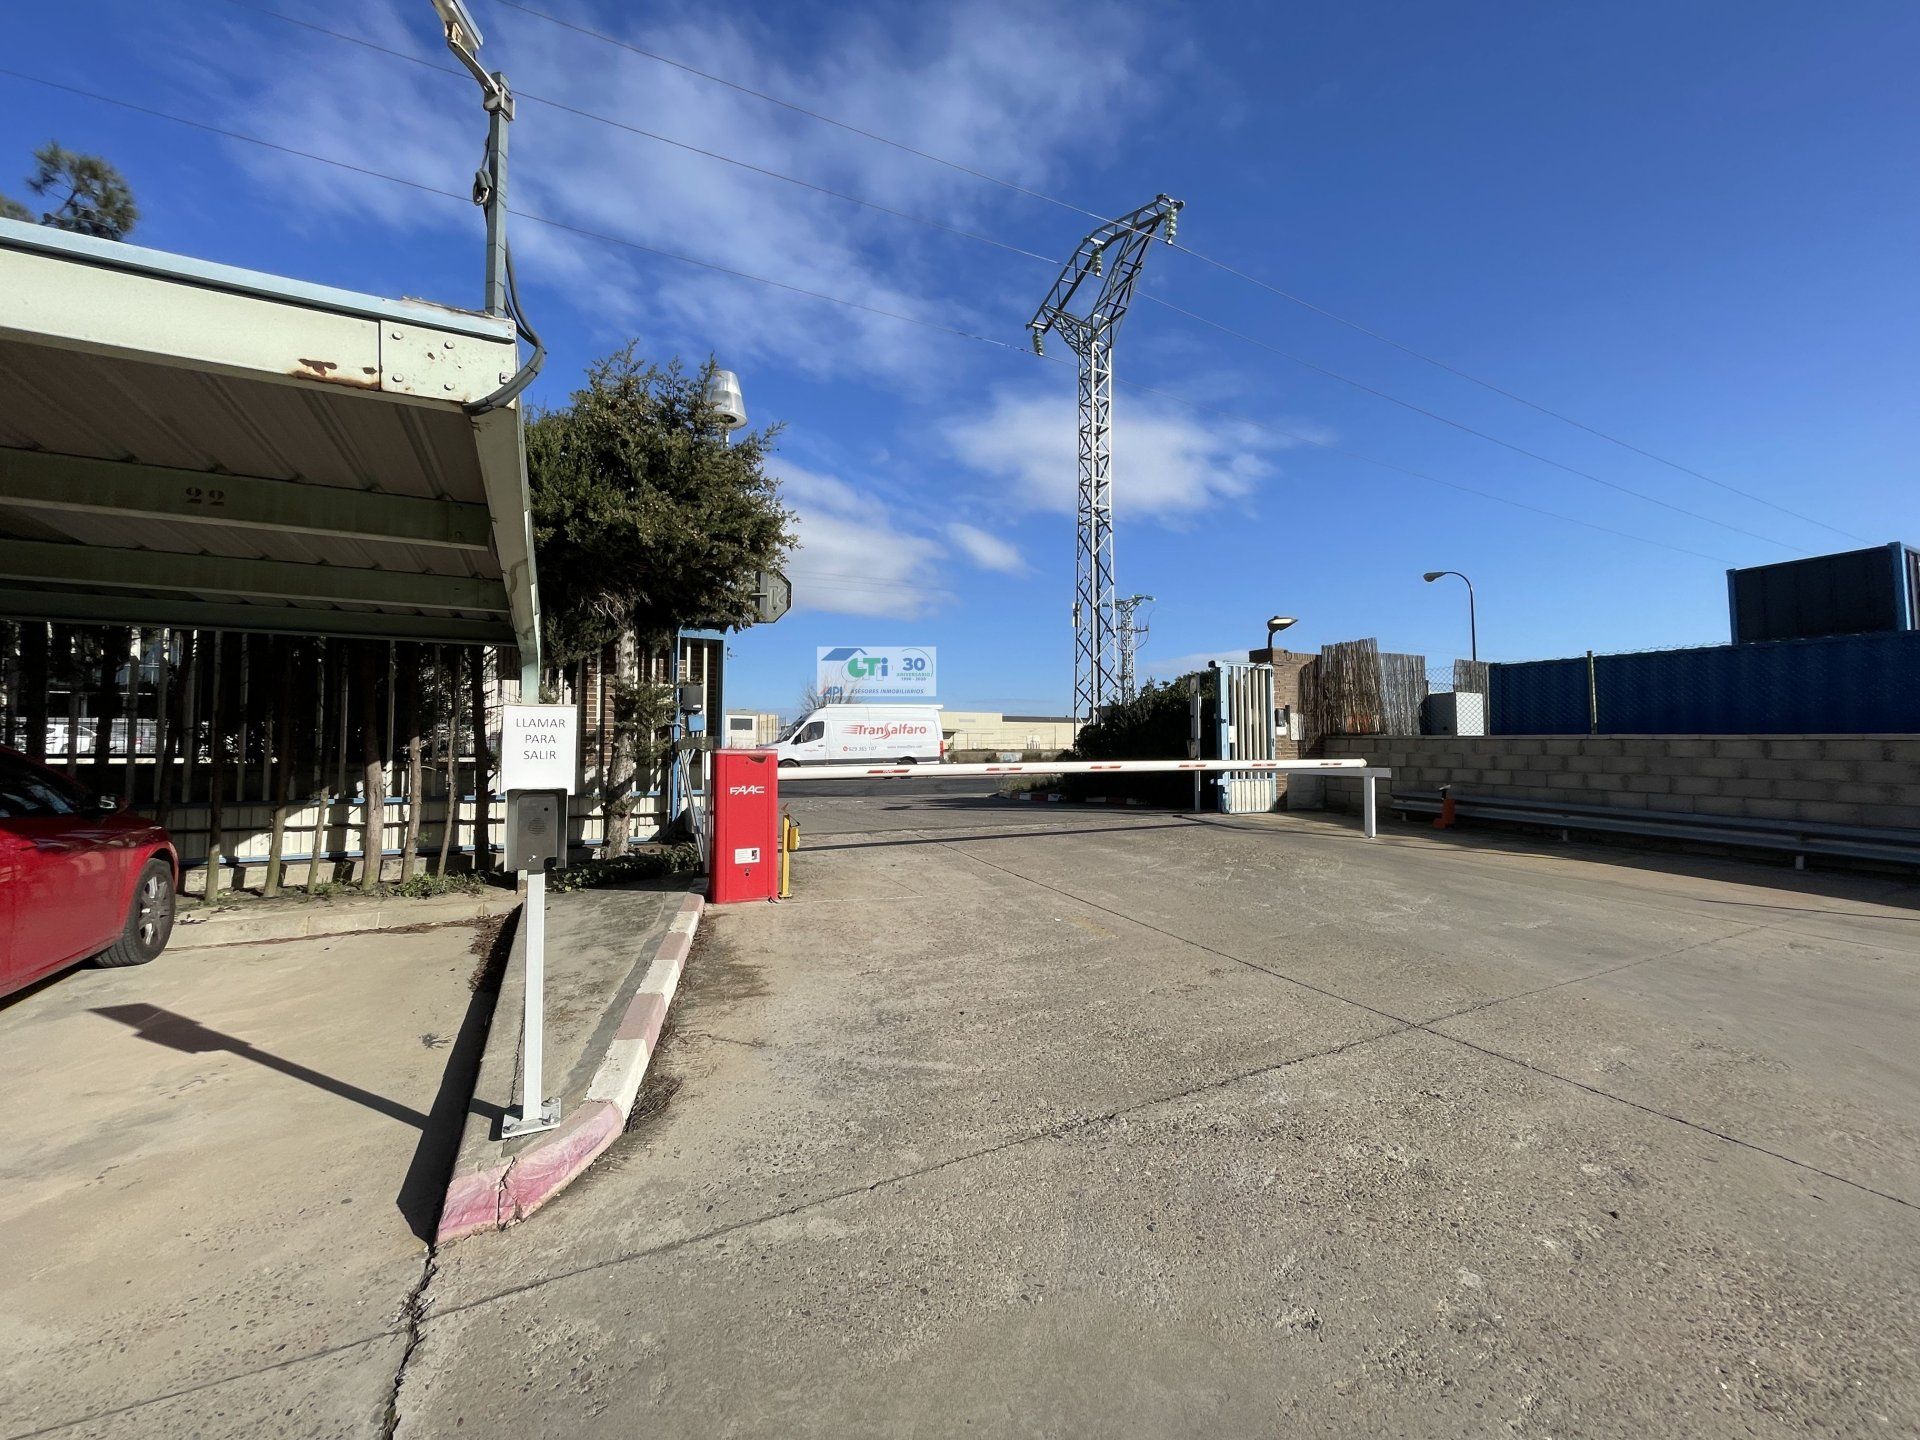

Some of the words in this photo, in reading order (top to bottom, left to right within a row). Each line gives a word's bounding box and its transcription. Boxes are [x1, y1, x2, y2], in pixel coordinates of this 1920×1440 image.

[184, 487, 225, 507] 22
[515, 718, 566, 728] LLAMAR
[525, 734, 557, 744] PARA
[523, 750, 557, 760] SALIR
[729, 785, 765, 795] FAAC
